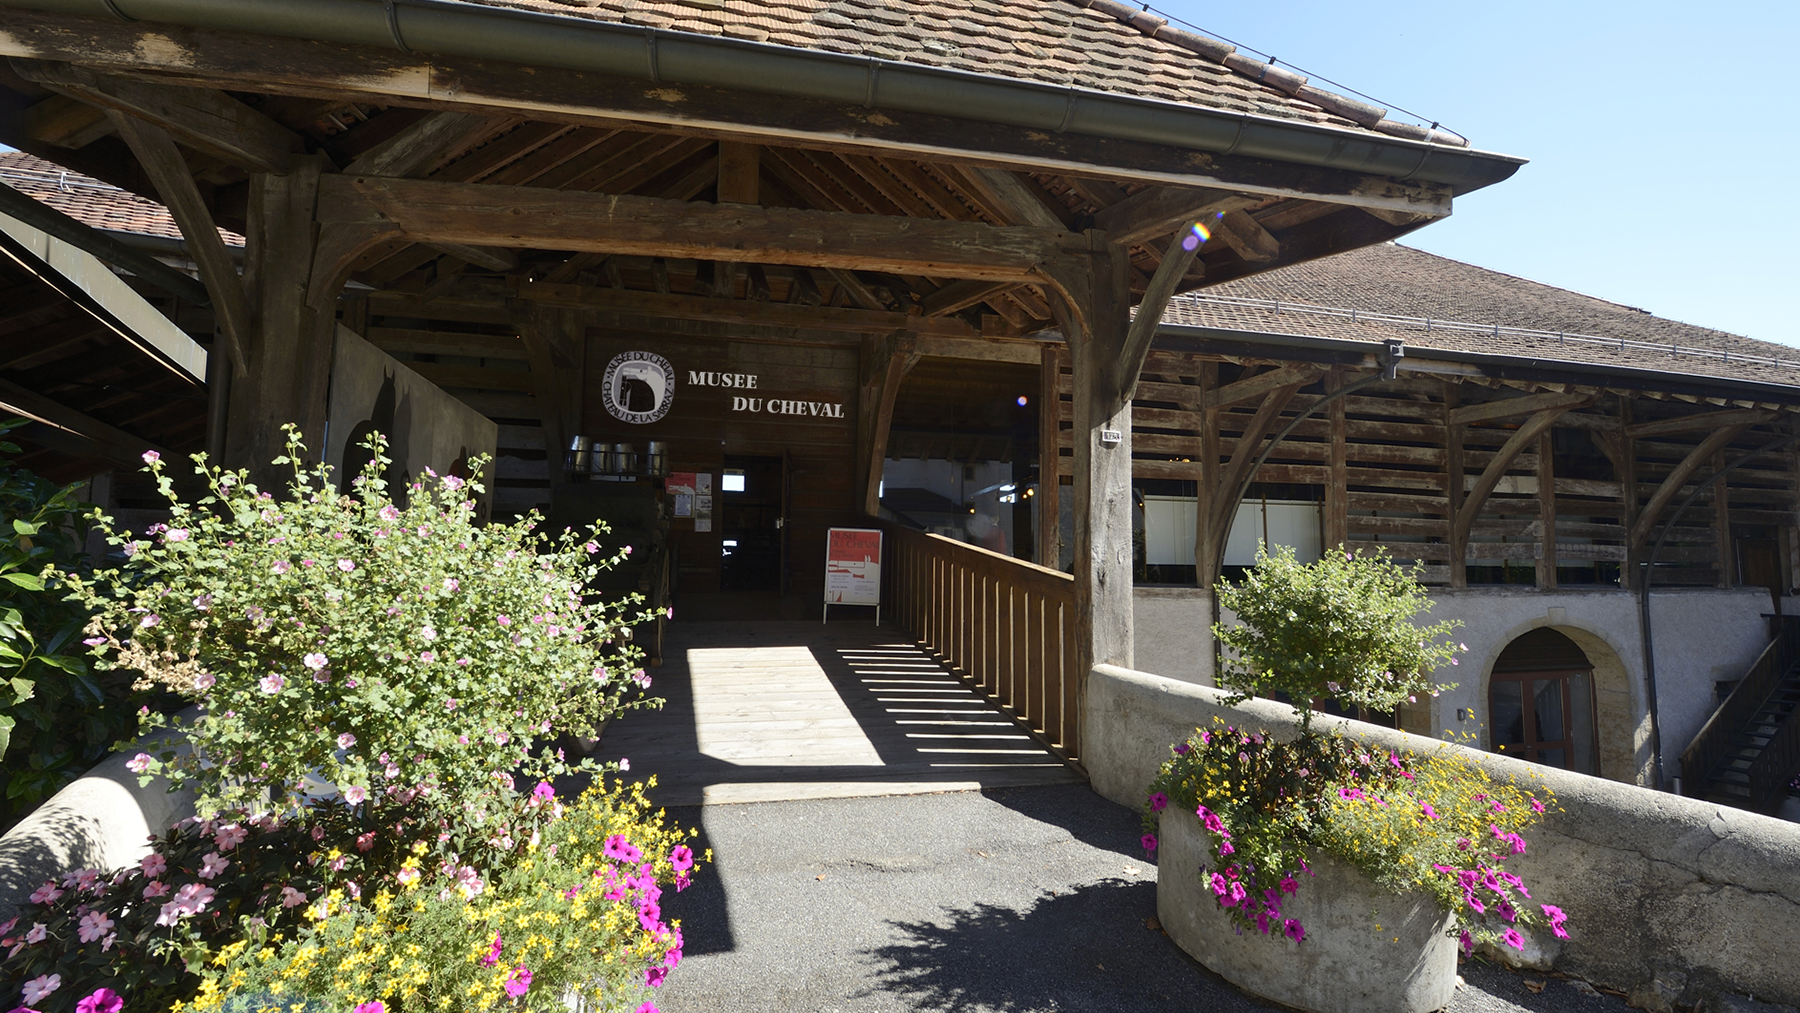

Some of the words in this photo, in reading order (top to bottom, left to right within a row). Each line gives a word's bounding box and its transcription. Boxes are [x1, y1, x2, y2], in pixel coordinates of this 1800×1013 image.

[633, 352, 649, 361] DU
[649, 353, 674, 383] CHEVAL
[688, 370, 758, 389] MUSEE
[625, 413, 639, 423] DE
[639, 413, 653, 423] LA
[652, 387, 674, 420] SARRAZ
[732, 396, 763, 413] DU
[766, 398, 845, 419] CHEVAL
